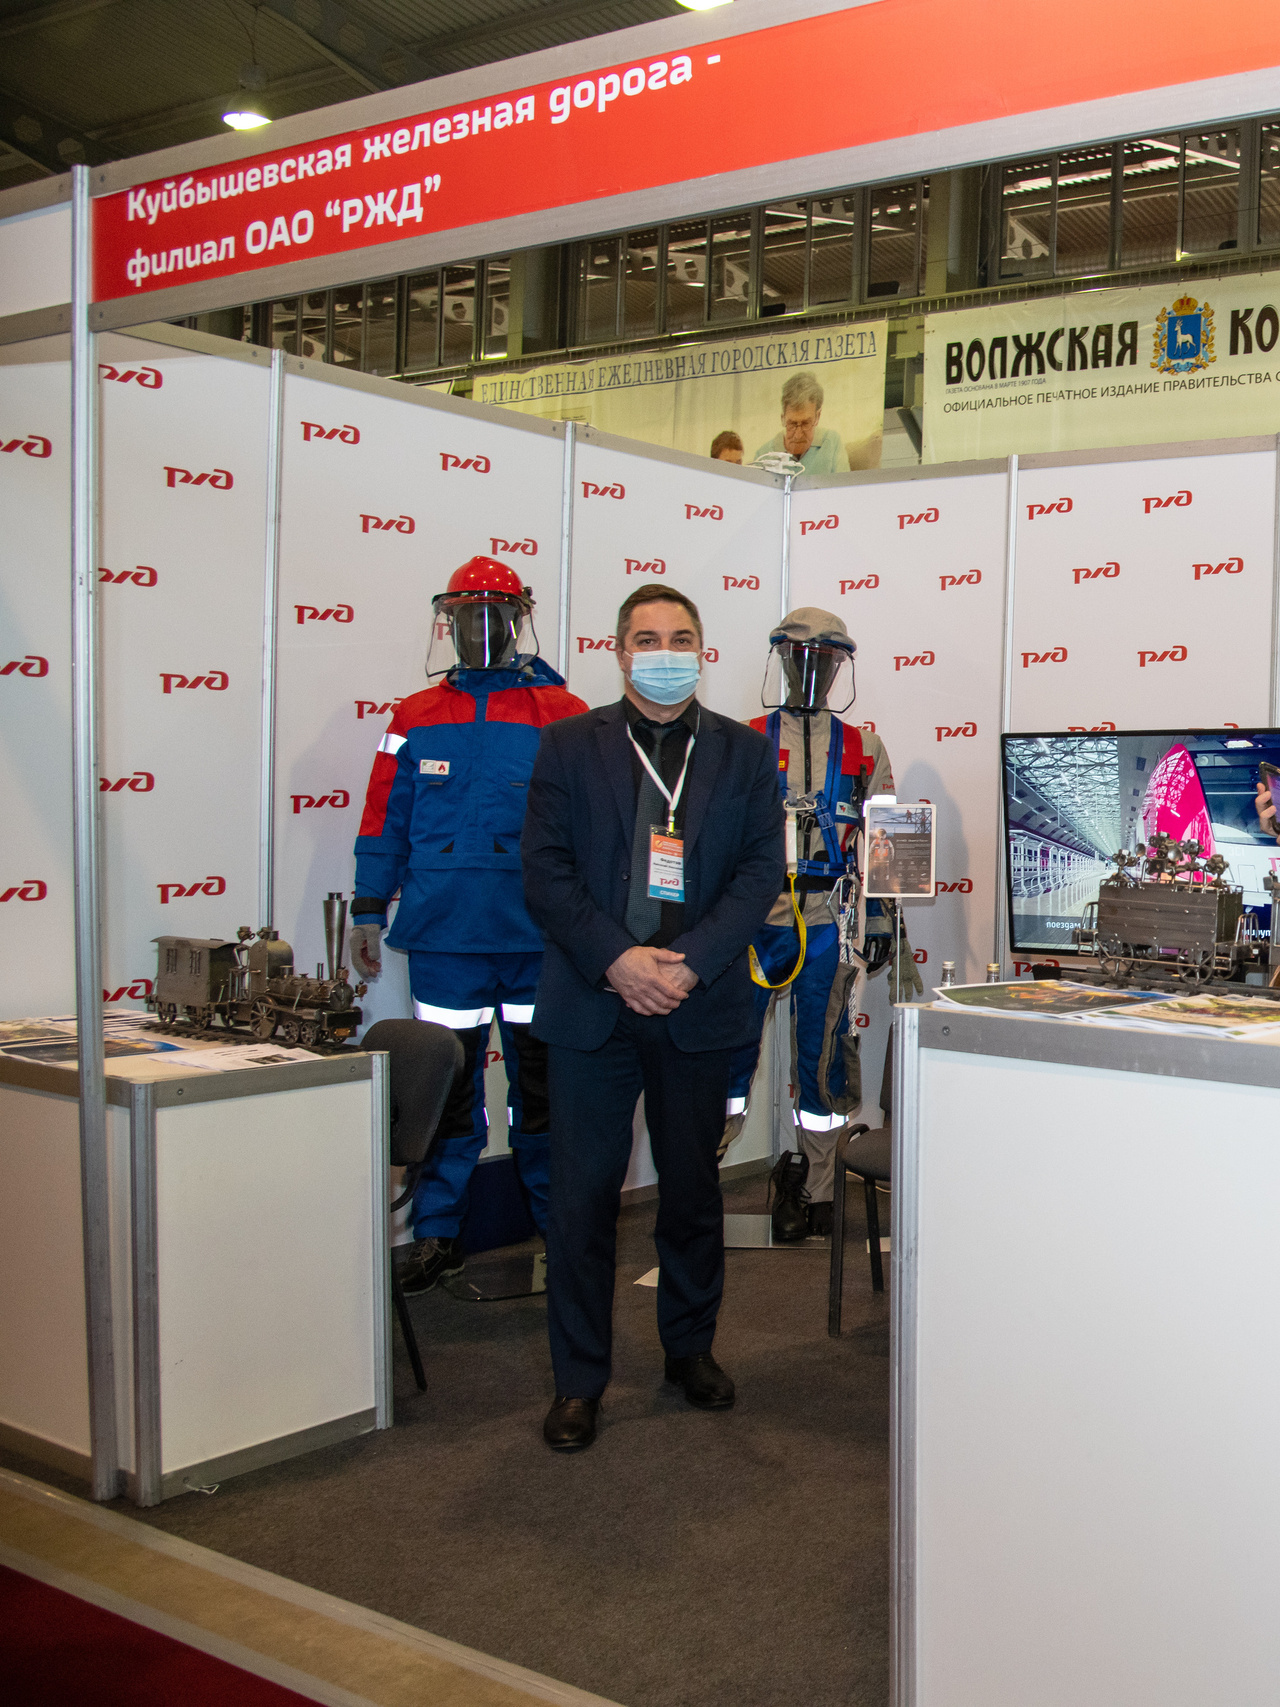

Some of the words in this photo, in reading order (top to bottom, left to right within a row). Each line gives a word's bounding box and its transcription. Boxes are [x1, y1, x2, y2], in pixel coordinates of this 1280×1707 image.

[127, 143, 352, 225] Куйбышевская
[363, 93, 535, 162] железная
[549, 55, 693, 125] дорога
[127, 237, 236, 287] филиал
[246, 209, 314, 255] ОАО
[481, 368, 594, 404] ЕДИНСТВЕННАЯ
[597, 352, 707, 388] ЕЖЕДНЕВНАЯ
[711, 339, 810, 373] ГОРОДСКАЯ
[815, 331, 877, 360] ГАЗЕТА
[945, 320, 1139, 385] ВОЛЖСКАЯ
[999, 380, 1017, 389] МАРТЕ
[943, 393, 1034, 414] ОФИЦИАЛЬНОЕ
[1036, 388, 1098, 405] ПЕЧАТНОЕ
[1100, 382, 1161, 399] ИЗДАНИЕ
[1163, 372, 1272, 392] ПРАВИТЕЛЬСТВА
